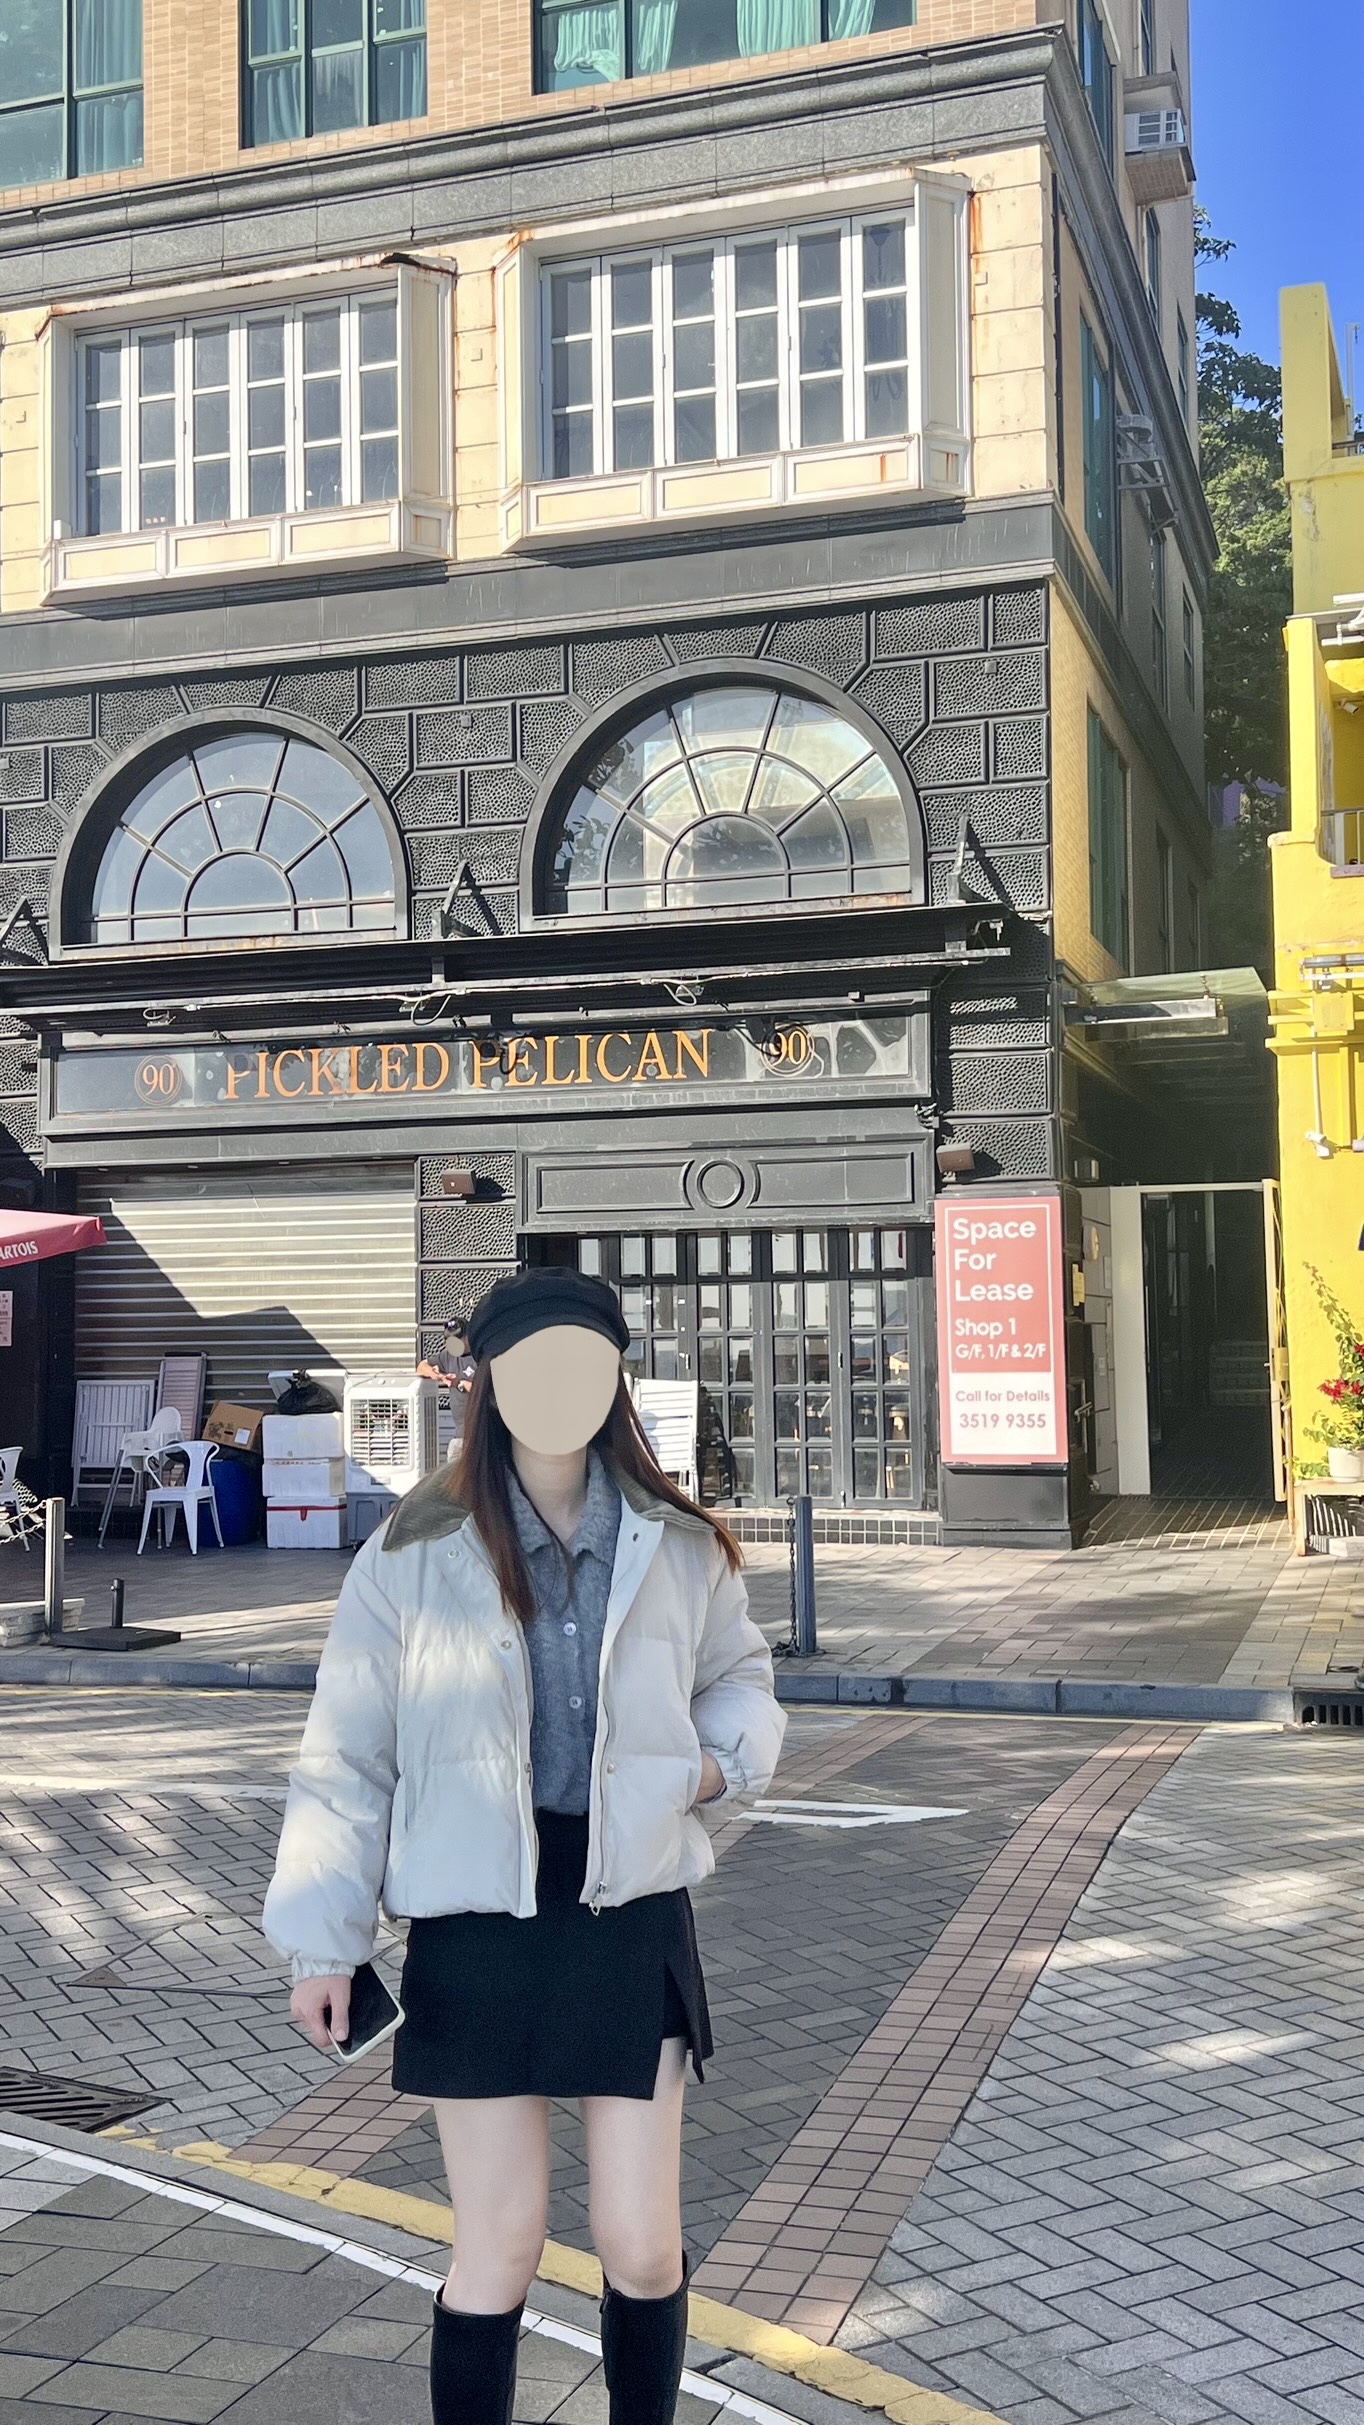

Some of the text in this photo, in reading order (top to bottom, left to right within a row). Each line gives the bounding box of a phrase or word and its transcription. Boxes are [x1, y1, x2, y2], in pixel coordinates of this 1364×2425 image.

[142, 1063, 174, 1096] 90
[467, 1028, 714, 1089] PELICAN
[768, 1030, 807, 1067] 90
[952, 1217, 1037, 1246] Space
[954, 1248, 997, 1271] For
[955, 1279, 1034, 1302] Lease
[954, 1317, 1017, 1340] Shop 1
[955, 1343, 986, 1360] G/F,
[955, 1389, 1051, 1402] Call for Details
[959, 1413, 1047, 1429] 3519 9355
